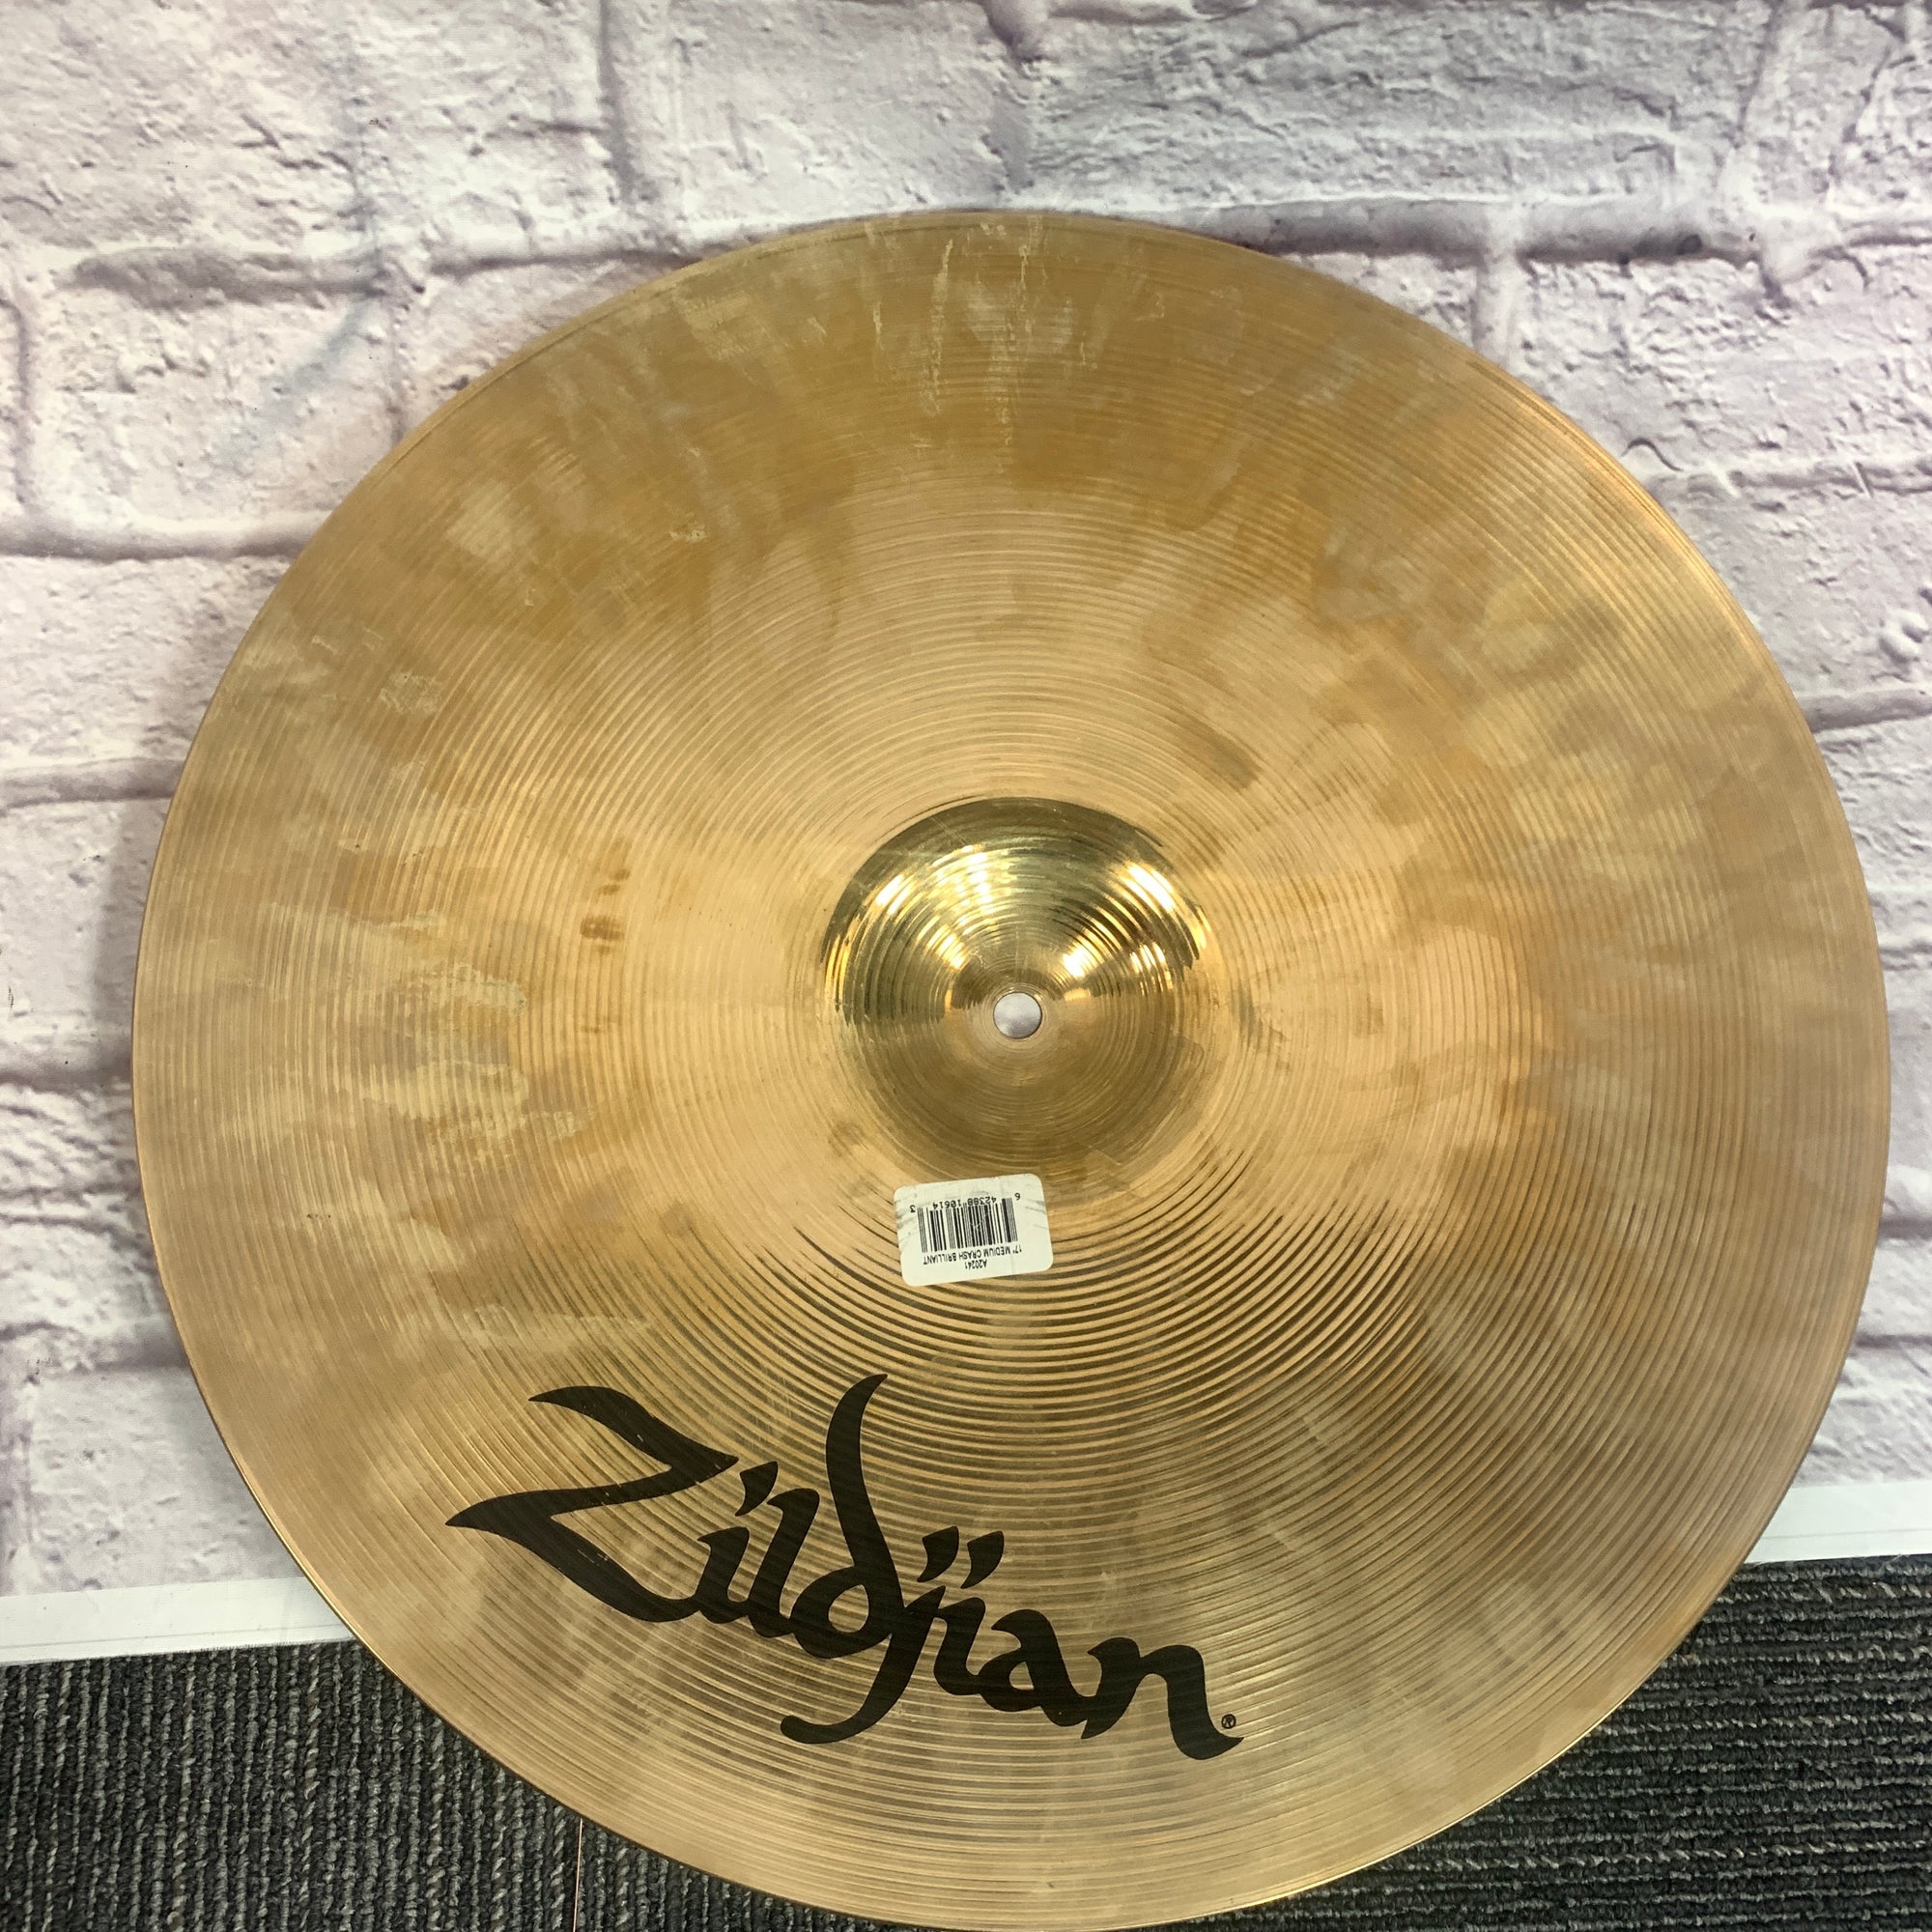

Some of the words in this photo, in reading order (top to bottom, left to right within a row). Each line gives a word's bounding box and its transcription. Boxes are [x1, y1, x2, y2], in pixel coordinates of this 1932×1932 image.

[967, 1196, 997, 1207] 42388
[1014, 1192, 1021, 1201] 6
[909, 1204, 916, 1213] 3
[932, 1199, 961, 1209] 10614
[957, 1249, 982, 1261] CRASH
[983, 1245, 1010, 1258] MEDIUM
[923, 1252, 957, 1265] BRILLIANT
[965, 1259, 988, 1270] A20241
[444, 1374, 1244, 1760] Zildjian
